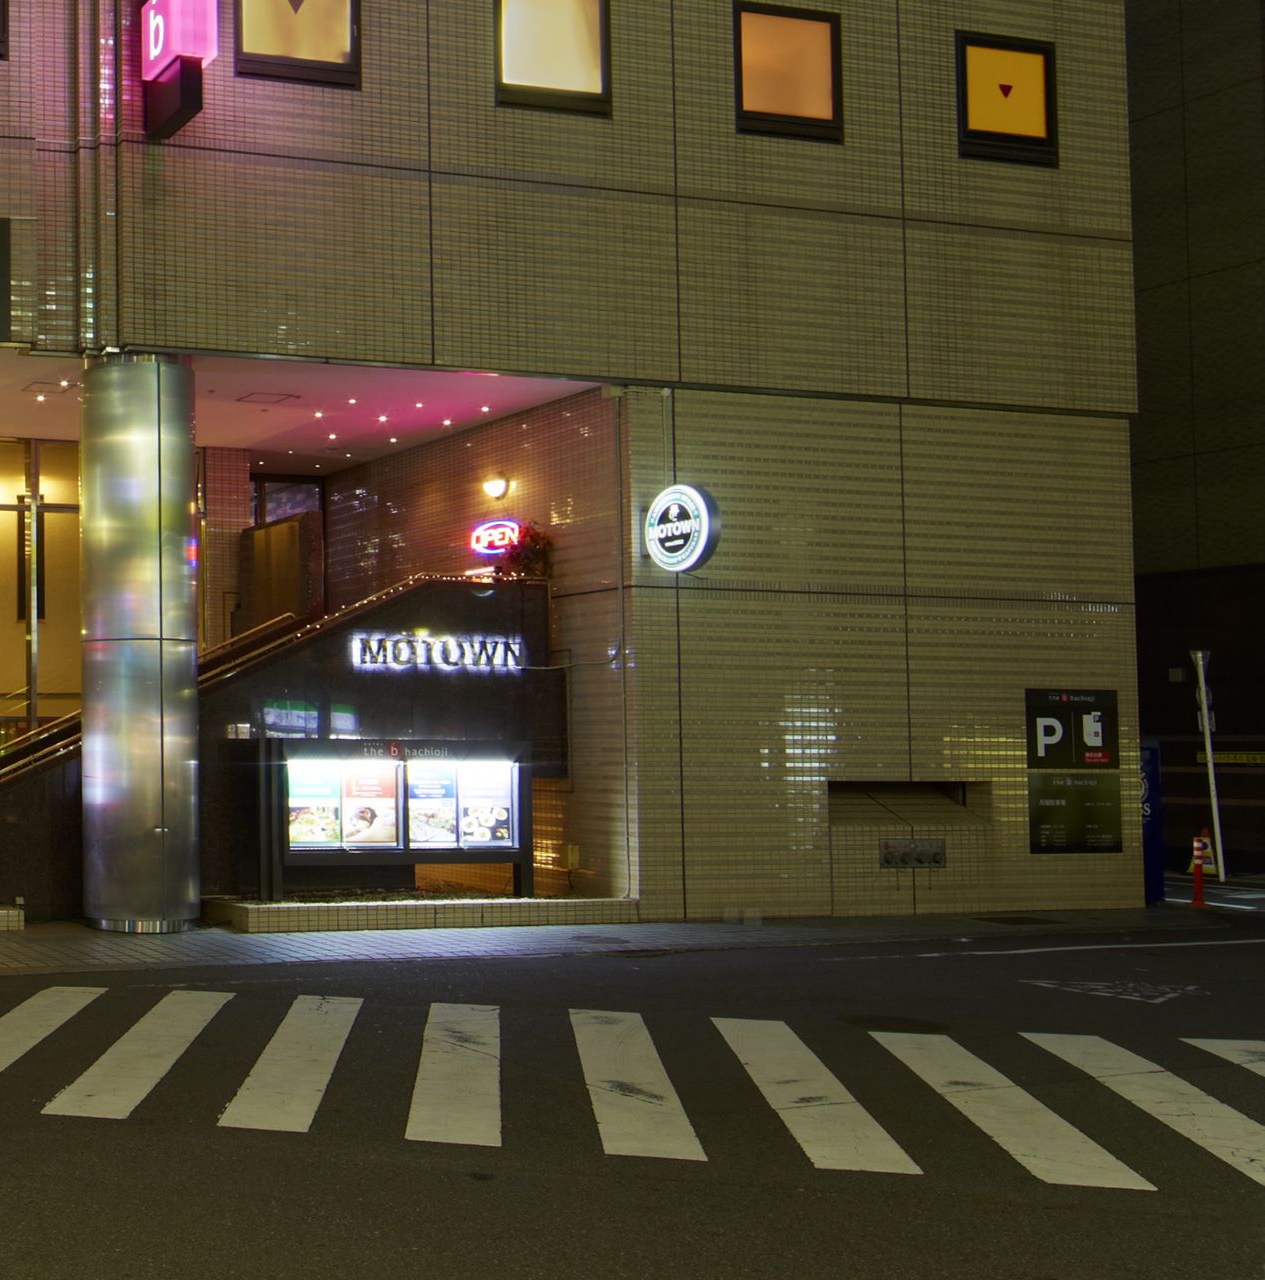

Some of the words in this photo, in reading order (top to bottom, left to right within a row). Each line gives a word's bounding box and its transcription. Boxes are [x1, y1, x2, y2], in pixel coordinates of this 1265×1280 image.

[471, 526, 519, 549] OPEN
[648, 518, 700, 540] MOTOWN
[355, 636, 526, 669] MOTOWN
[1036, 717, 1064, 757] P
[364, 747, 383, 756] the
[405, 747, 448, 758] hachioji
